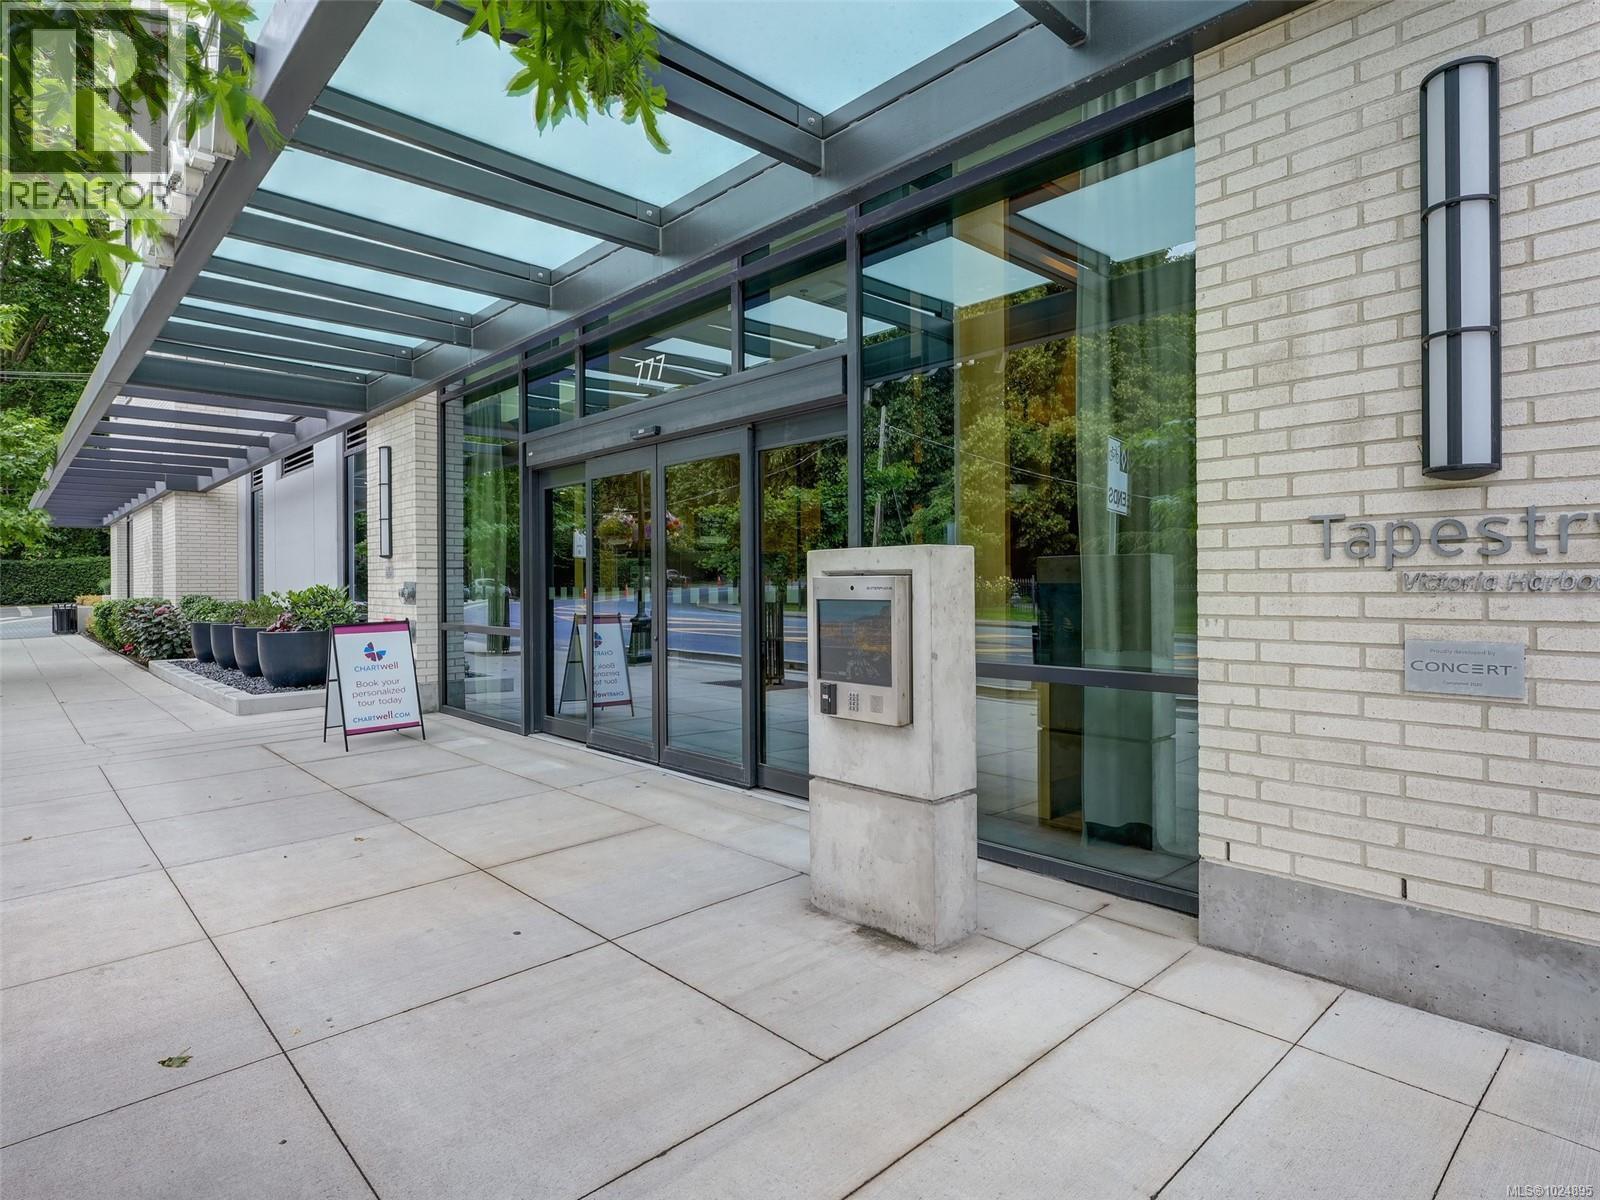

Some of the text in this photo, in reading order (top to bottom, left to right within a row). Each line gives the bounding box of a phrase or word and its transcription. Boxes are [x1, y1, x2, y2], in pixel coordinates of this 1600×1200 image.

[634, 353, 666, 386] 777
[1308, 504, 1600, 571] Tapestr
[1402, 571, 1498, 592] Victoria
[354, 661, 399, 672] CHARTwell
[1410, 660, 1513, 677] CONCERT
[355, 679, 400, 688] Book your
[352, 687, 406, 699] personalized
[378, 697, 403, 705] today
